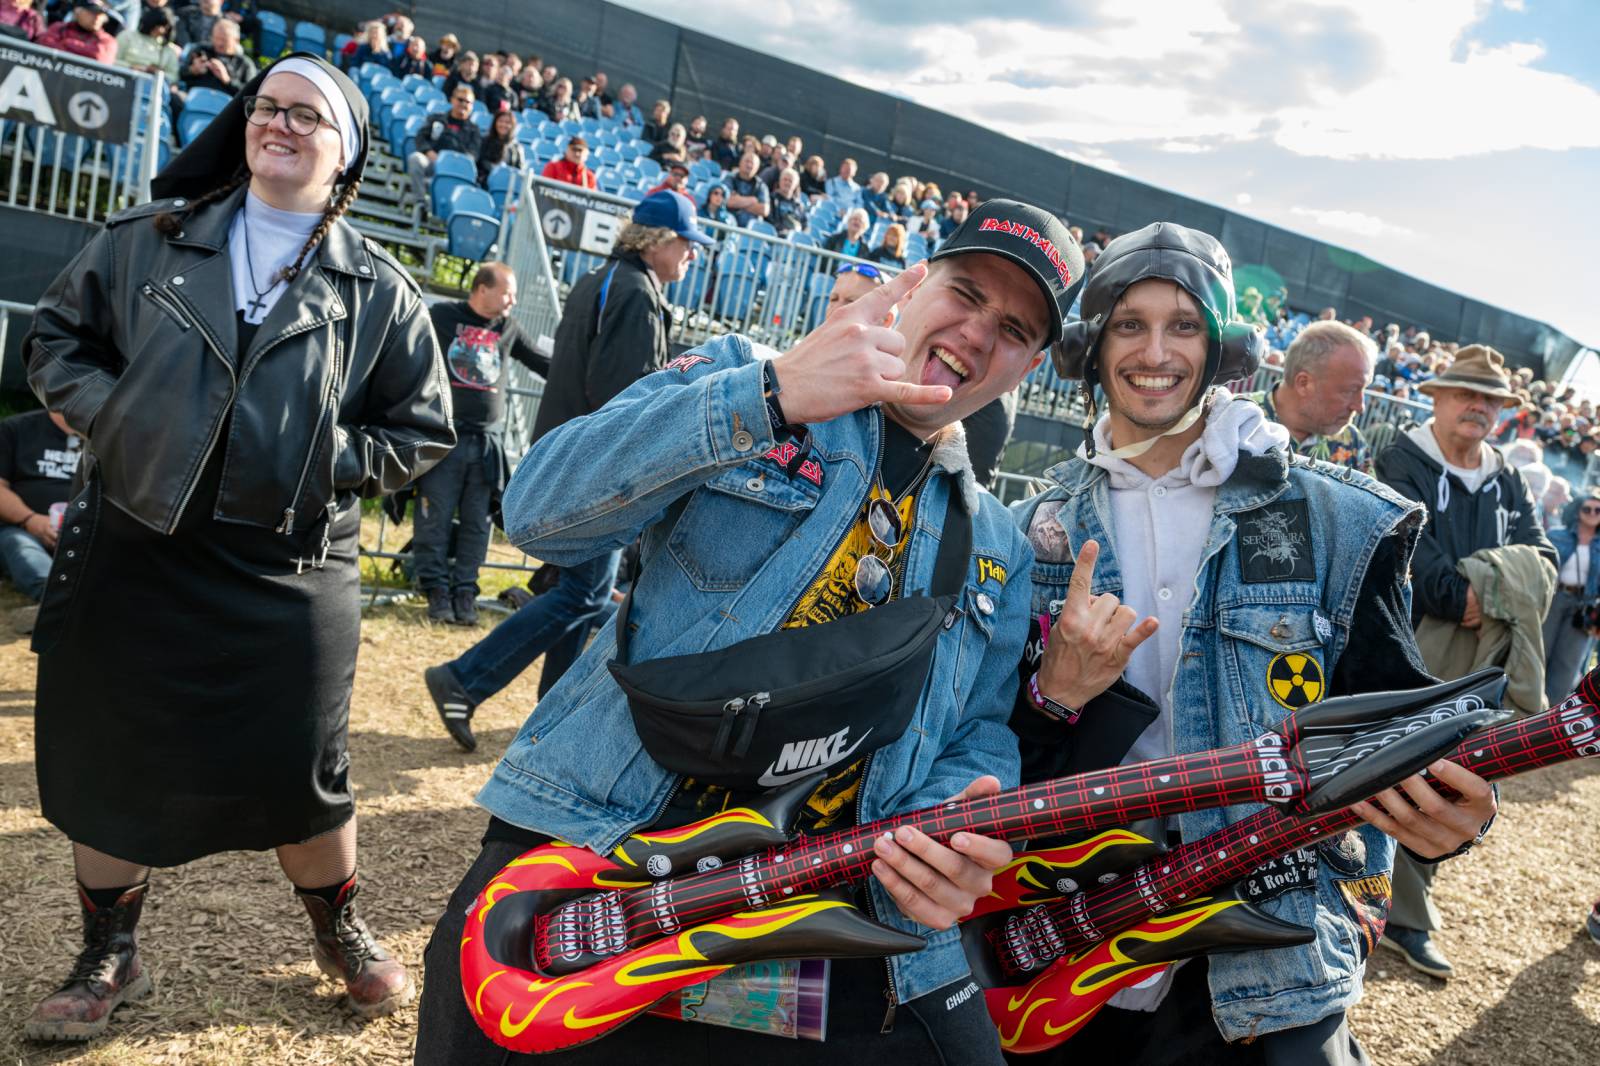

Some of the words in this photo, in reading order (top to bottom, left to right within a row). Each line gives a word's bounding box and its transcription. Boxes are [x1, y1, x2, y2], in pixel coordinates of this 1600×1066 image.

[0, 47, 53, 71] IBUNA
[63, 63, 126, 88] SECTOR
[0, 65, 57, 125] A
[580, 208, 620, 256] B
[979, 218, 1025, 236] IRON
[1023, 226, 1072, 289] MAIDEN
[775, 725, 850, 773] NIKE
[1248, 879, 1262, 896] &
